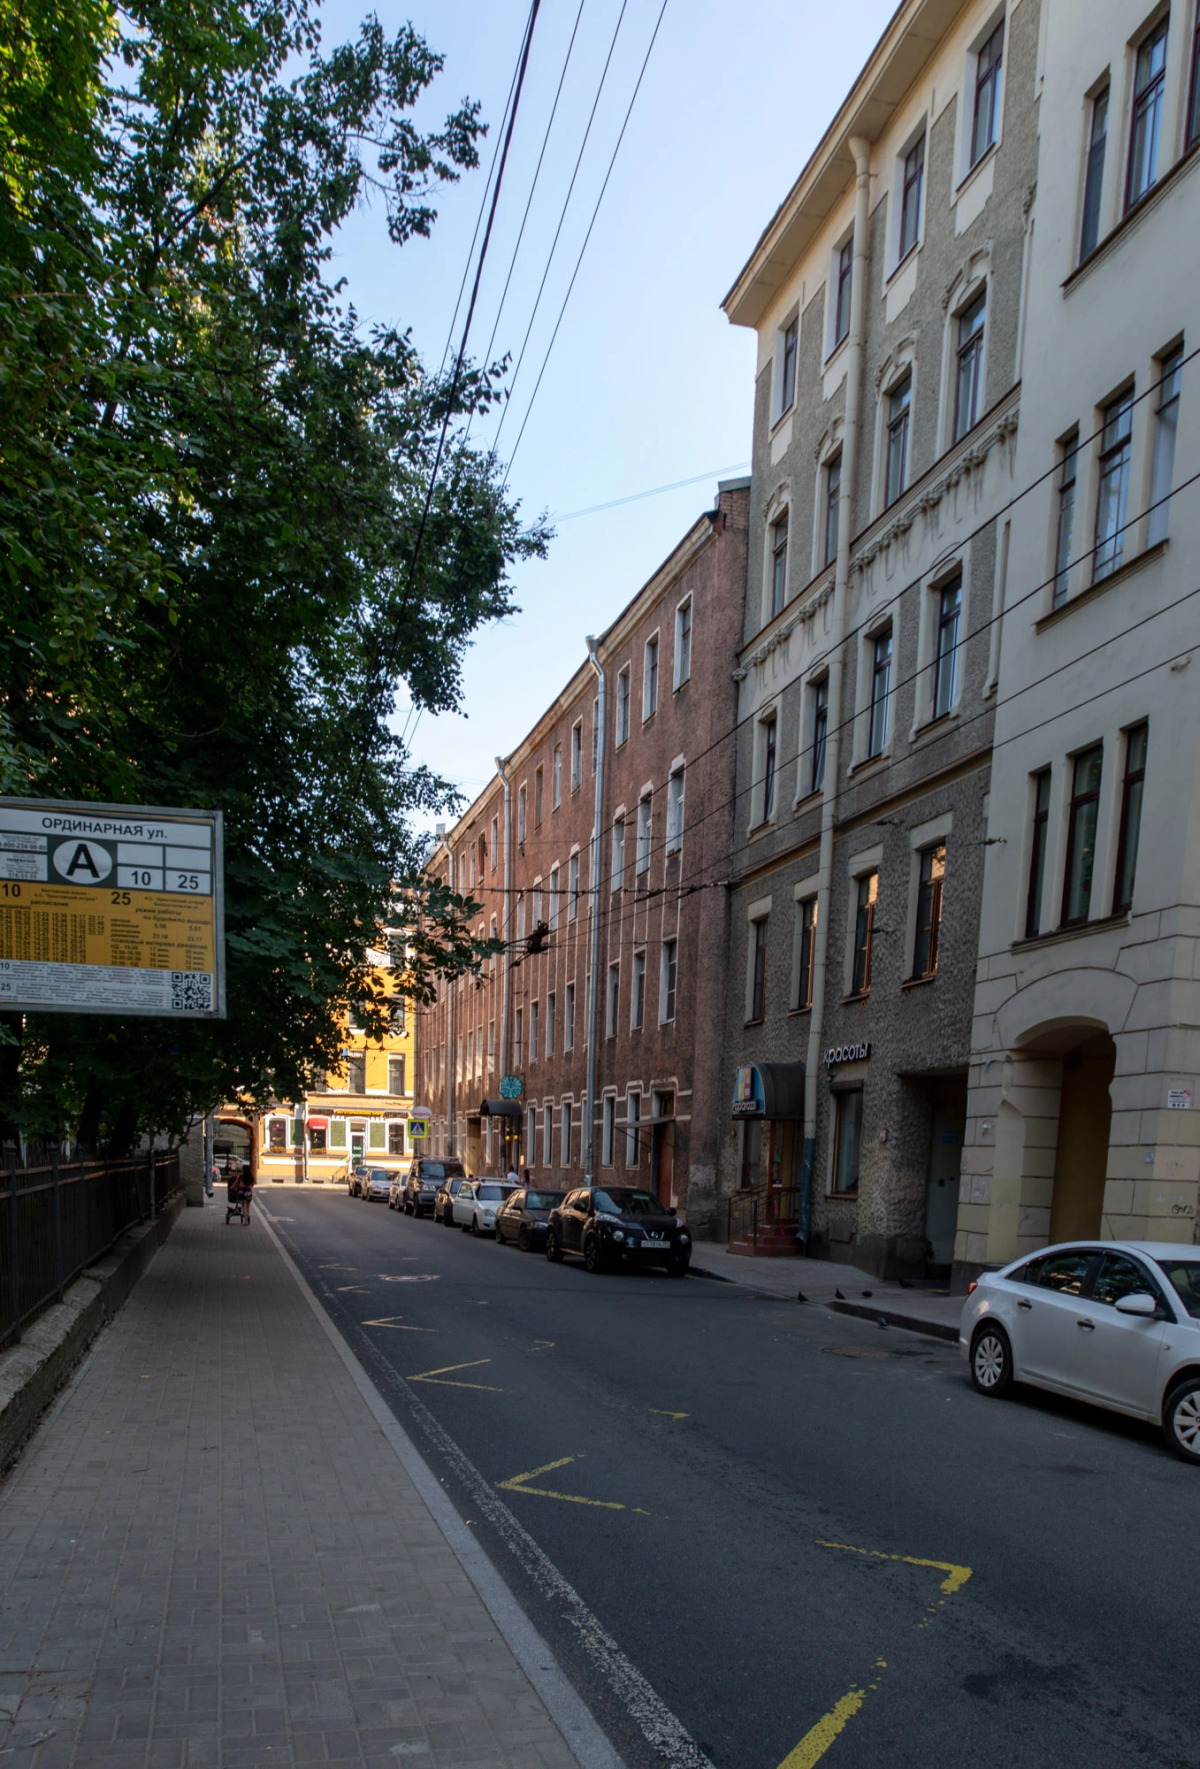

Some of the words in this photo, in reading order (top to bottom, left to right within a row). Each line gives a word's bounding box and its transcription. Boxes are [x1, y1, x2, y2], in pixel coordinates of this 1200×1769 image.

[42, 817, 143, 836] ОРДИНАРНАЯ
[147, 828, 168, 839] ул.
[66, 843, 100, 879] А
[131, 871, 152, 886] 10
[178, 874, 199, 890] 25
[2, 884, 21, 898] 10
[111, 891, 131, 906] 25
[0, 962, 10, 970] 10
[0, 983, 11, 991] 25
[823, 1042, 869, 1068] красоты
